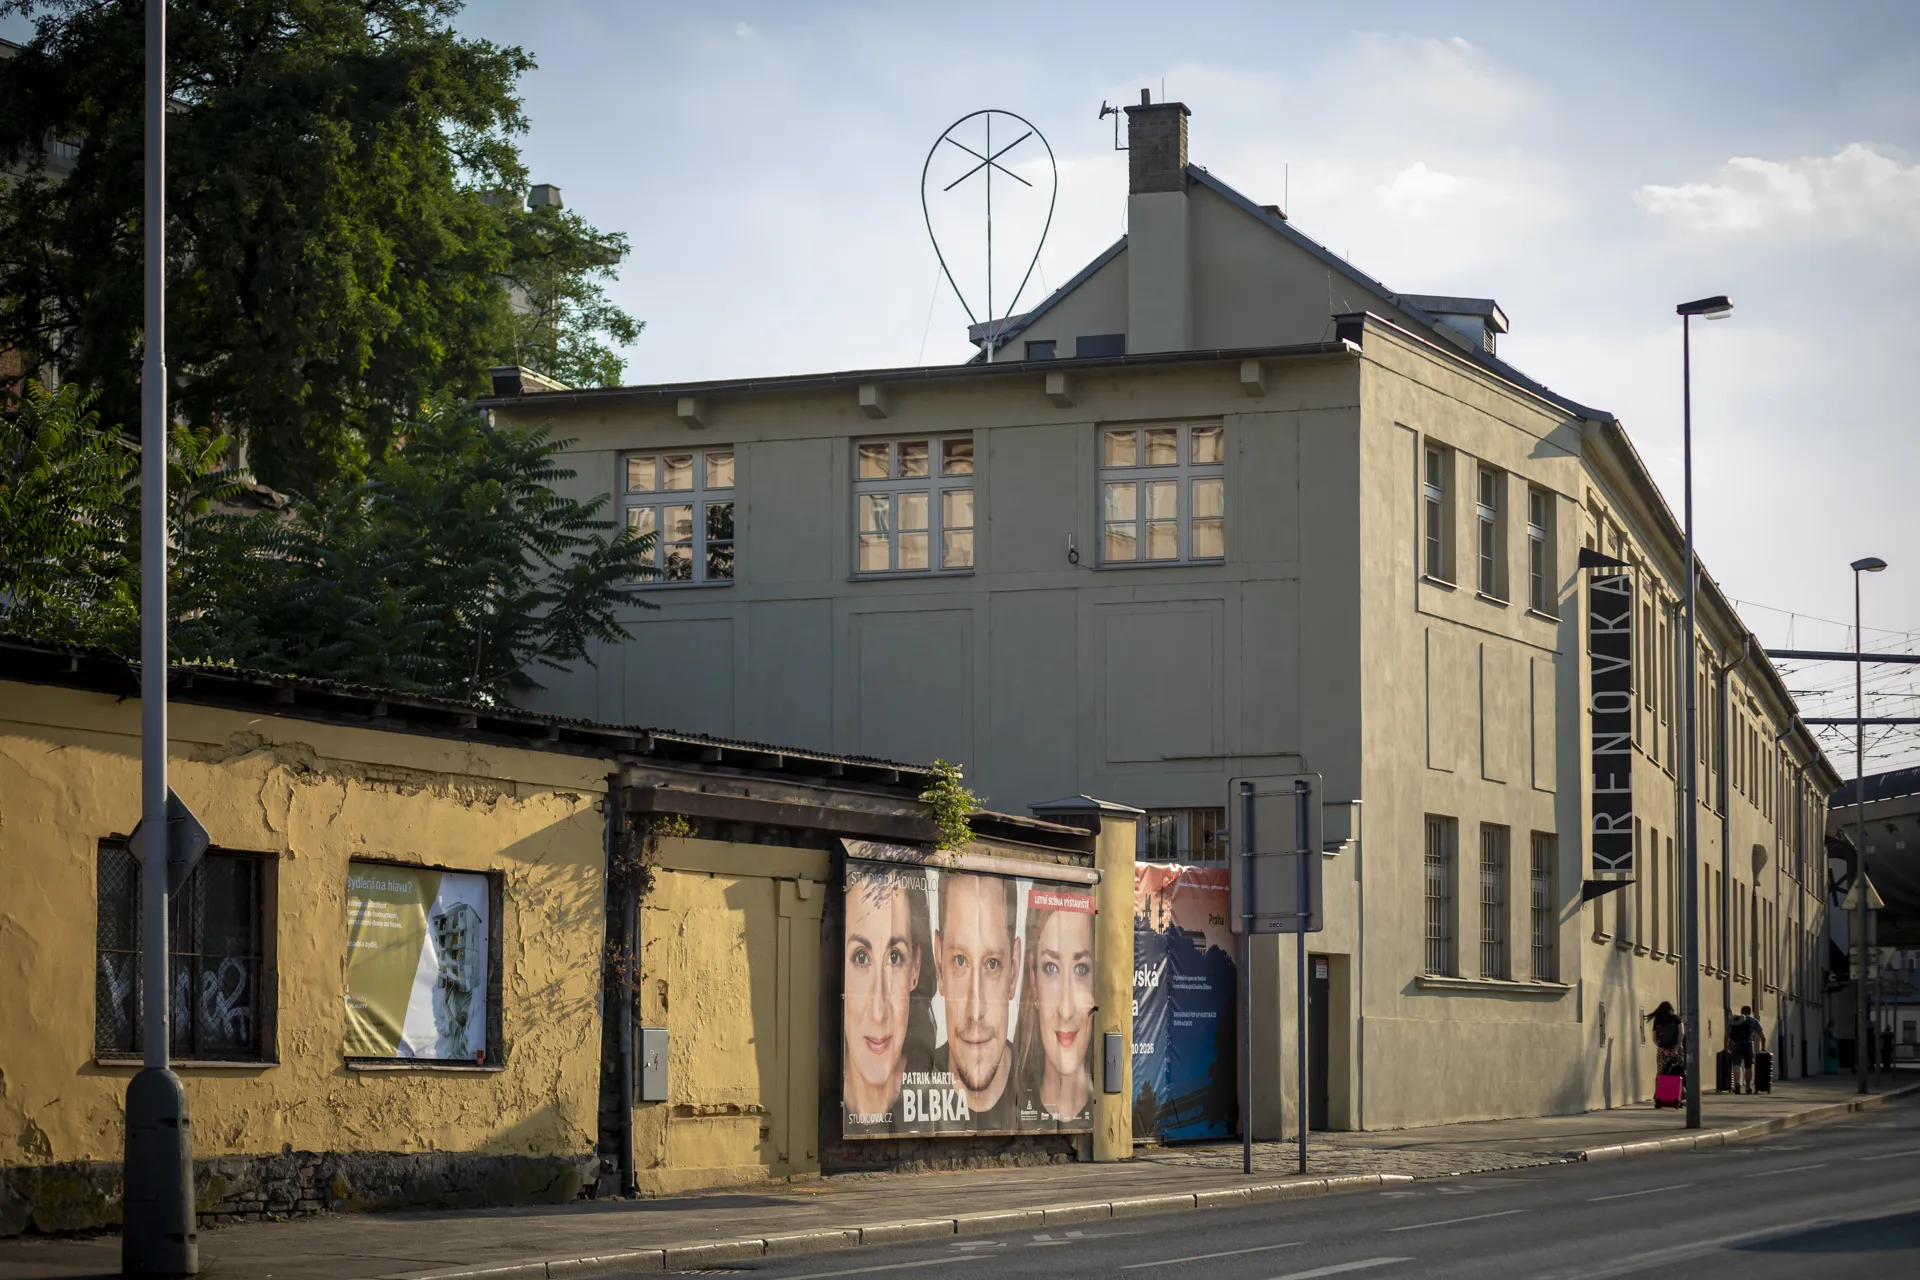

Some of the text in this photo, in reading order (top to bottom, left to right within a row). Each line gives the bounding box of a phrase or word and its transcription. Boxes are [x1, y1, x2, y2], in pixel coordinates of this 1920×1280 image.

[1590, 574, 1633, 873] KRENOVKA
[376, 881, 386, 890] na
[388, 880, 412, 893] hlavu?
[1034, 894, 1048, 905] LETNÍ
[1048, 895, 1064, 907] SCÉNA
[1208, 914, 1225, 926] Praha
[903, 1072, 956, 1084] PATRIK HARTL
[903, 1089, 970, 1122] BLBKA
[849, 1113, 892, 1124] STUDIODVA.CZ
